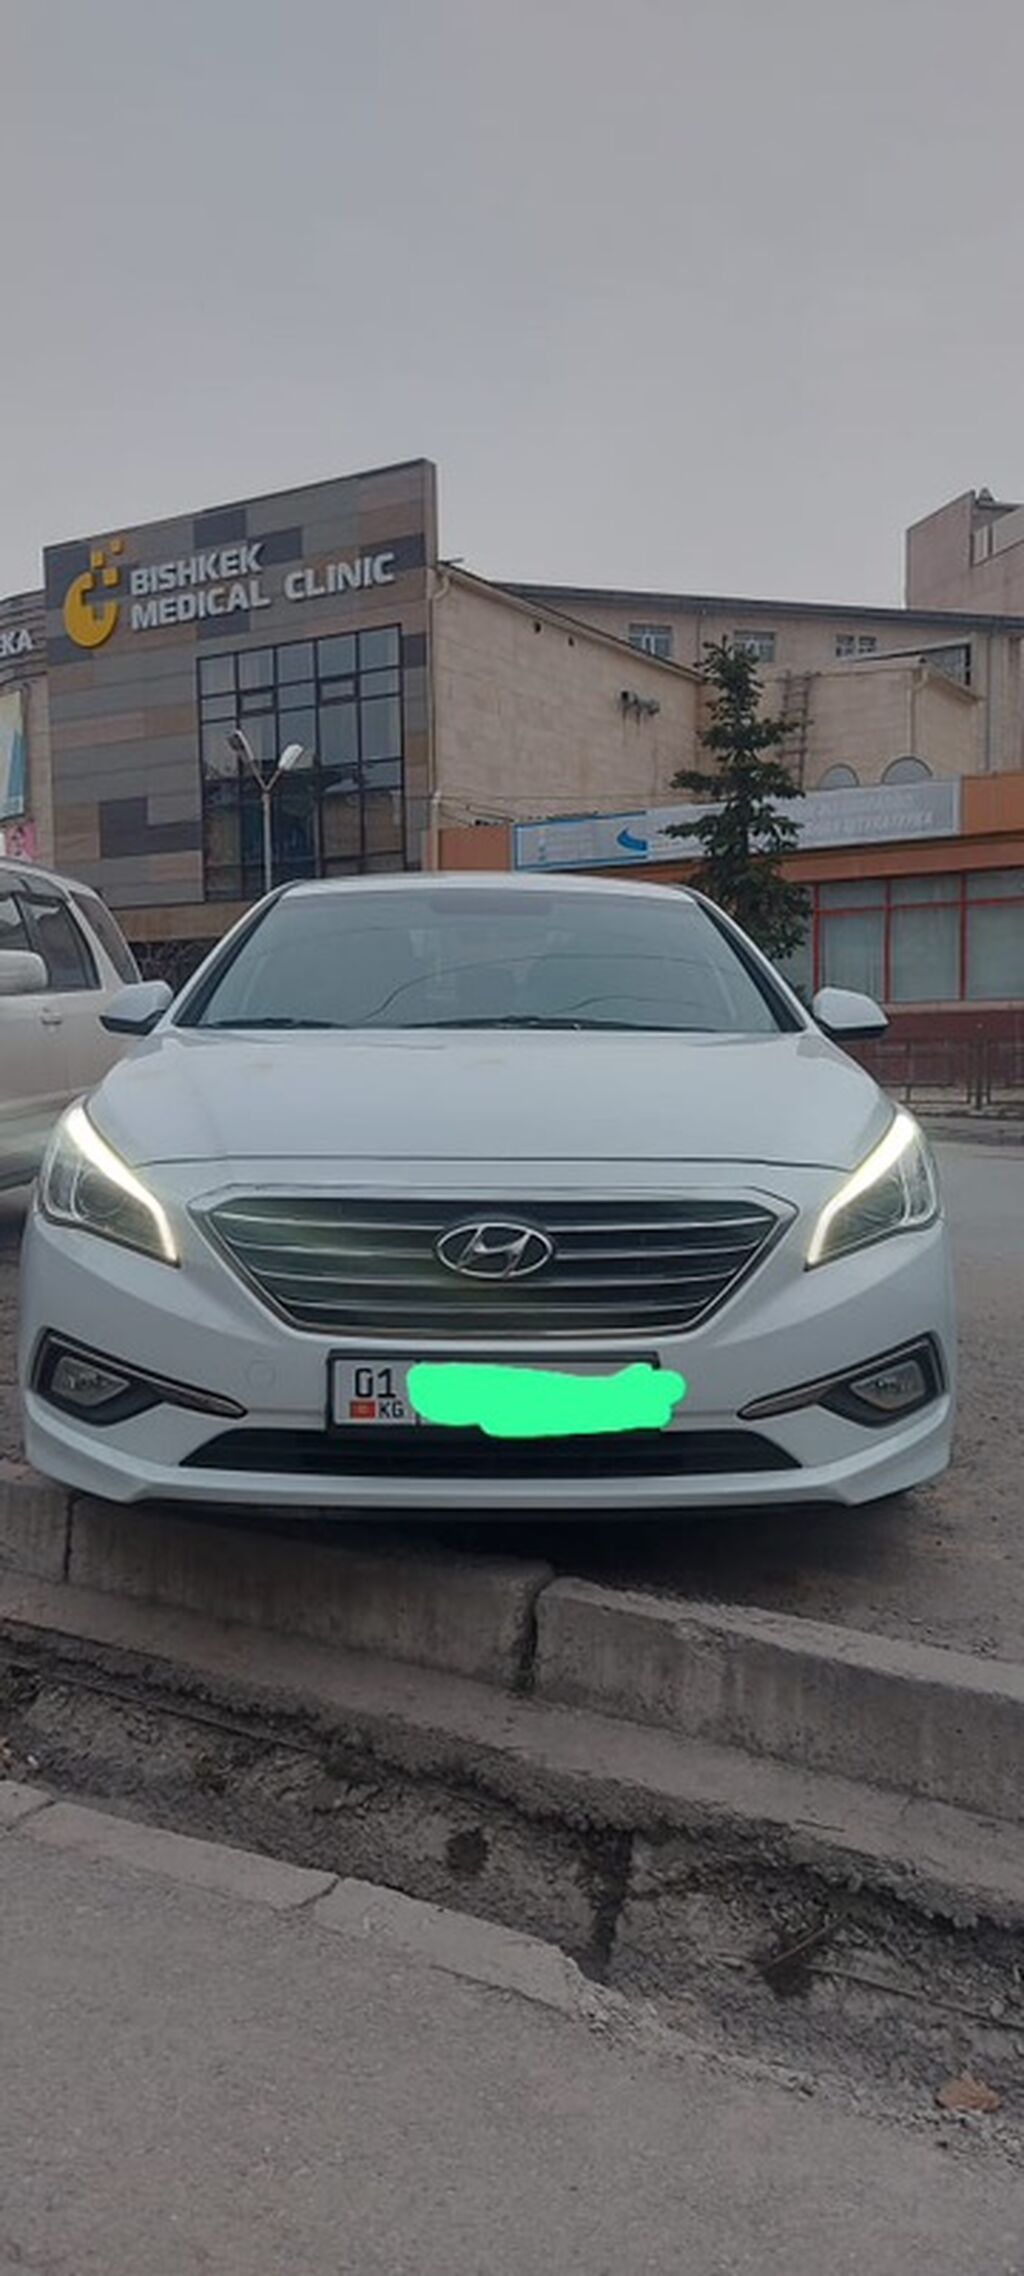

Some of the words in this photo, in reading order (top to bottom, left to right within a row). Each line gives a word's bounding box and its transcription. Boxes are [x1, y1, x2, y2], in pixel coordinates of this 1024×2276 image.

[130, 542, 265, 596] BISHKEK
[130, 580, 272, 630] MEDICAL
[283, 552, 396, 600] CLINIC
[355, 1367, 397, 1398] 01
[379, 1401, 404, 1419] KG
